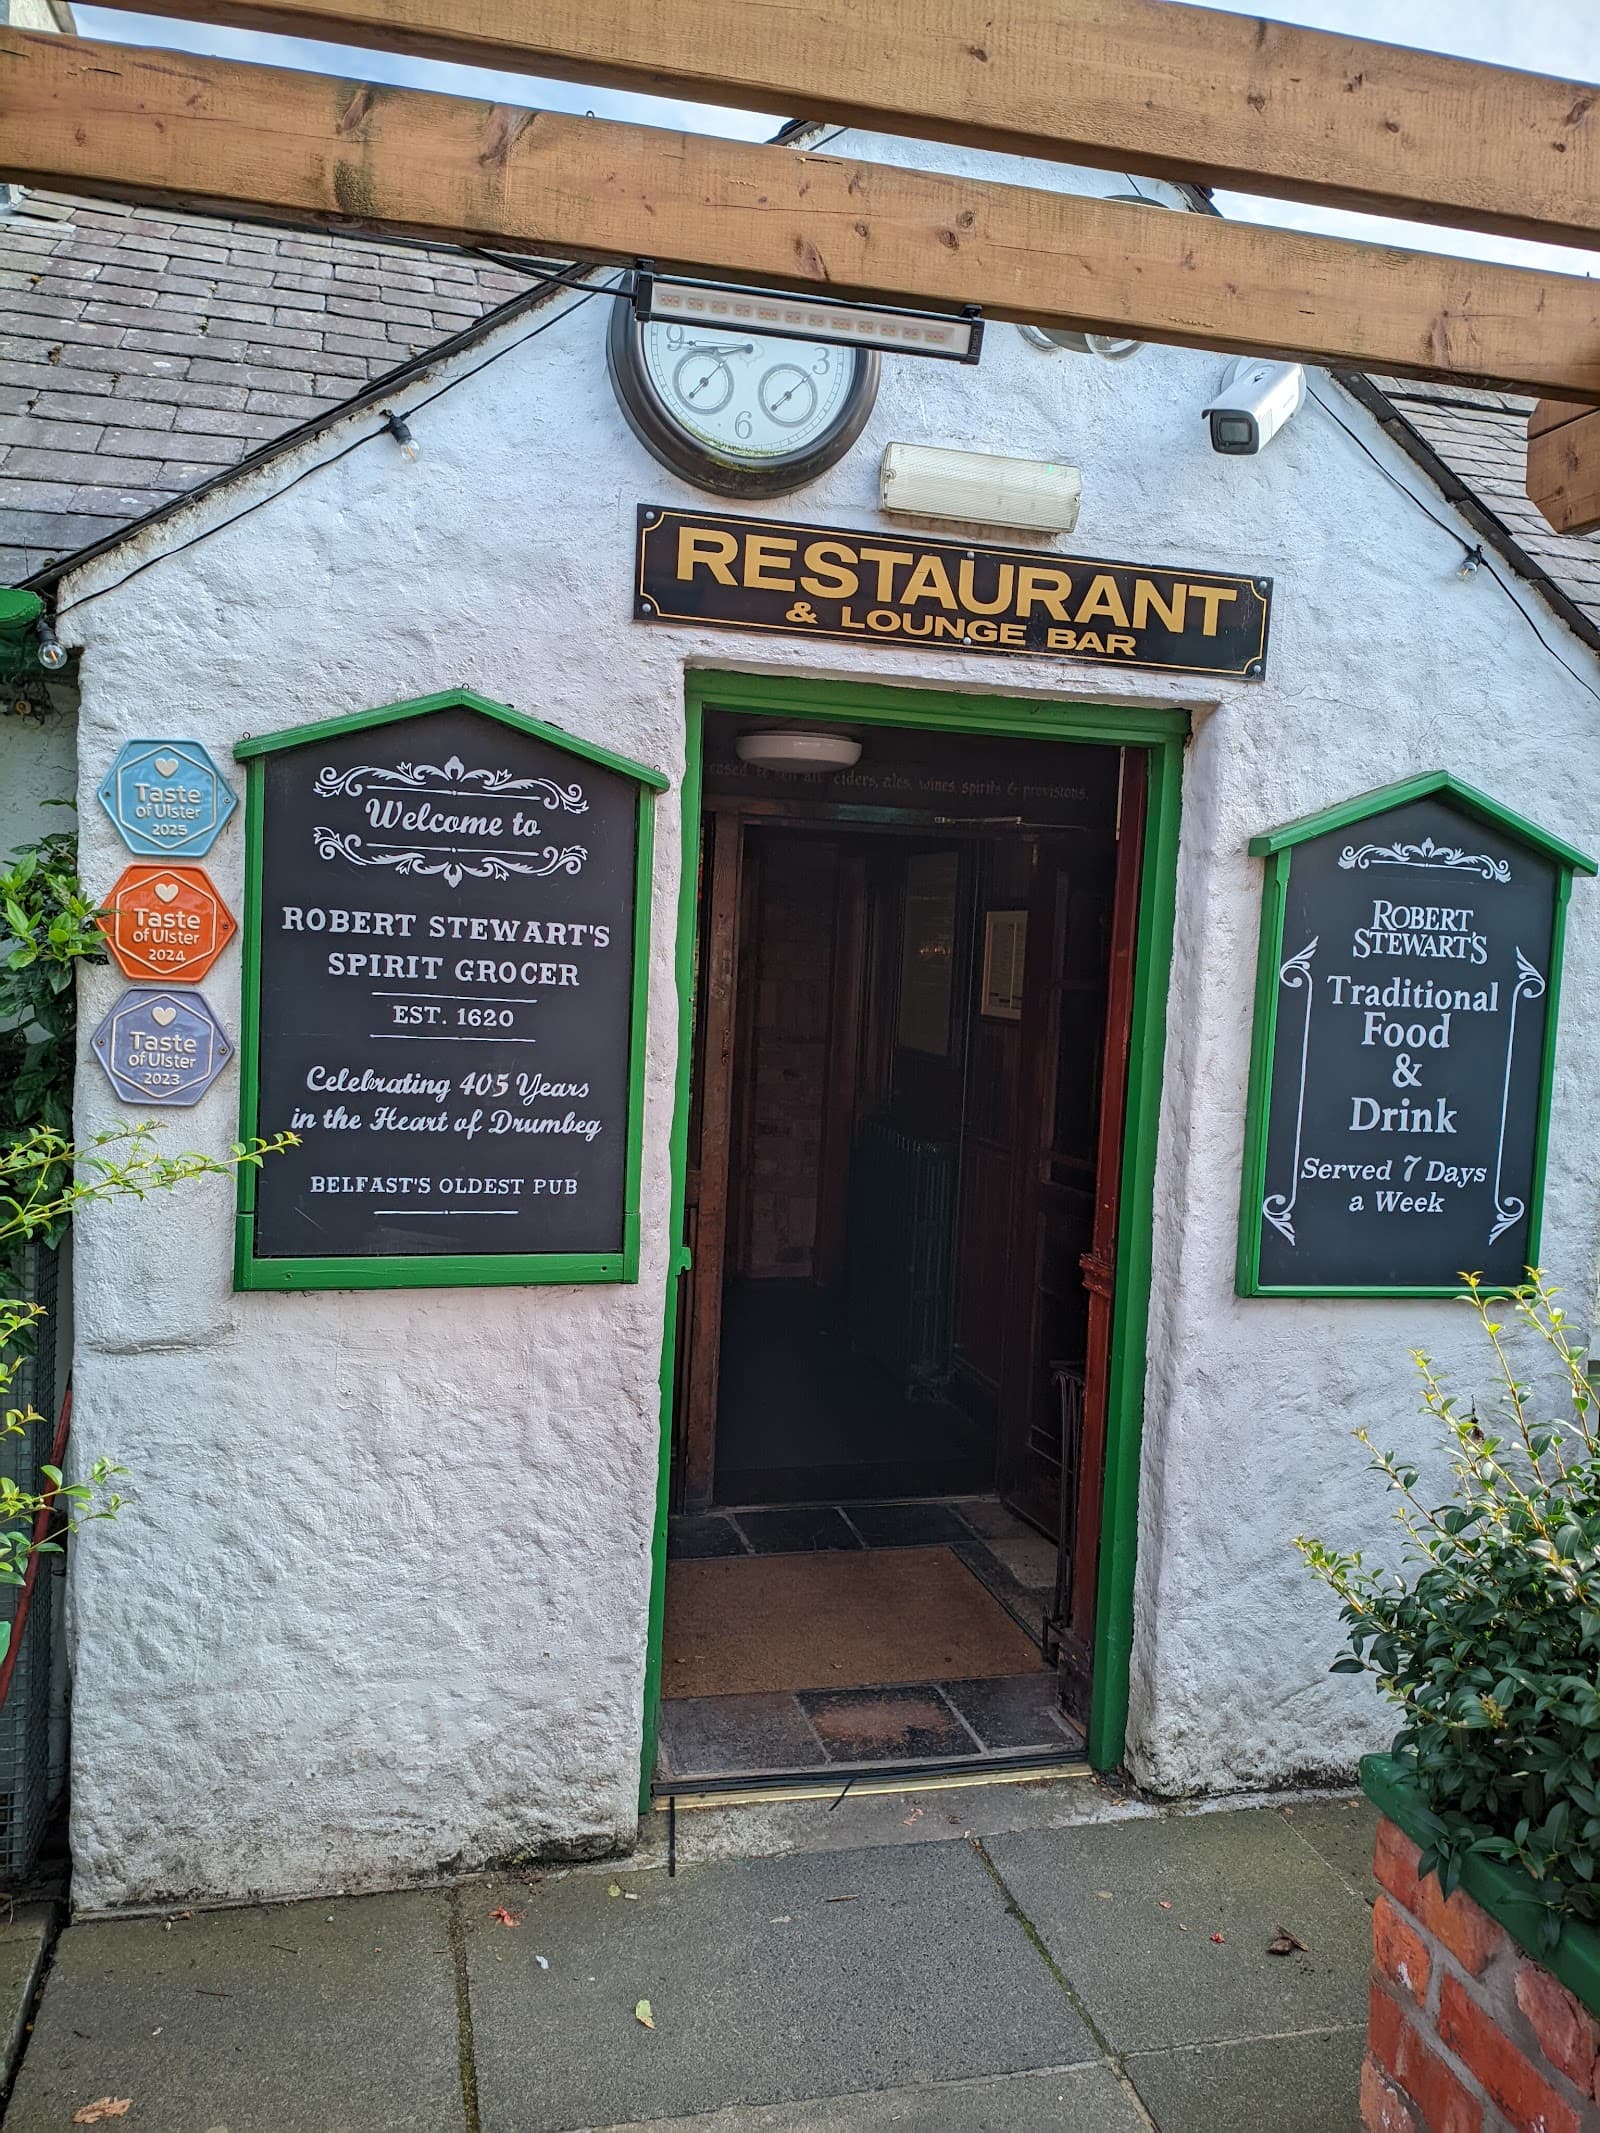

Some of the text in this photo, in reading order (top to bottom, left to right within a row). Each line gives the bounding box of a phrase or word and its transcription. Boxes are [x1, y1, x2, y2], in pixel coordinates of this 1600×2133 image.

[666, 324, 684, 352] 9
[812, 346, 830, 375] 3
[734, 410, 753, 440] 6
[677, 526, 1238, 637] RESTAURANT
[786, 602, 1137, 656] & LOUNGE BAR
[134, 783, 201, 804] Taste
[136, 803, 201, 819] of Ulster
[366, 799, 541, 837] Welcome to
[152, 824, 188, 836] 2025
[133, 908, 201, 930] Taste
[282, 907, 610, 948] ROBERT STEWART'S
[1371, 899, 1474, 932] ROBERT
[133, 928, 200, 945] of Ulster
[1353, 928, 1488, 964] STEWART'S
[149, 949, 186, 963] 2024
[329, 953, 579, 986] SPIRIT GROCER
[1327, 975, 1499, 1012] Traditional
[393, 1006, 514, 1027] EST. 1620
[1361, 1012, 1451, 1049] Food
[129, 1031, 197, 1054] Taste
[129, 1051, 197, 1069] of Ulster
[1392, 1053, 1423, 1088] &
[144, 1072, 180, 1086] 2023
[306, 1065, 590, 1106] Celebrating 405 Years
[291, 1106, 602, 1142] in the Heart of Drumbeg
[1349, 1097, 1457, 1134] Drink
[310, 1176, 578, 1195] BELFAST'S OLDEST PUB
[1301, 1154, 1488, 1188] Served 7 Days
[1348, 1190, 1445, 1213] a Week
